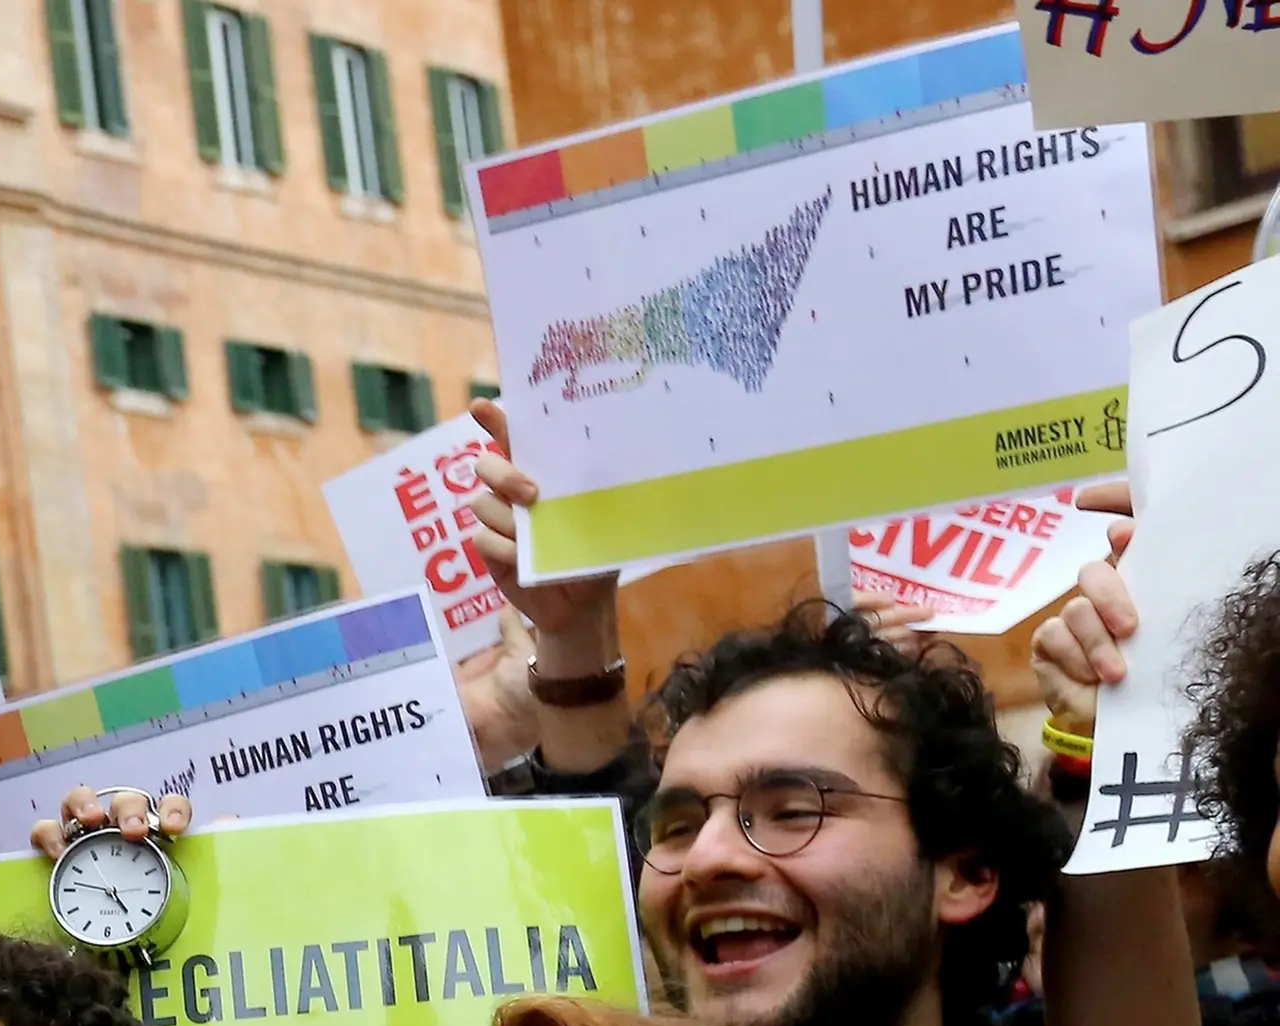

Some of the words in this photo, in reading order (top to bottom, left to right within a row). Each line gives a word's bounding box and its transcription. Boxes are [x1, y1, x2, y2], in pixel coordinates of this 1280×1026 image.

[850, 156, 963, 212] HUMAN
[976, 126, 1101, 182] RIGHTS
[947, 206, 1009, 250] ARE
[904, 279, 949, 319] MY
[962, 254, 1065, 306] PRIDE
[995, 416, 1087, 453] AMNESTY
[996, 441, 1089, 470] INTERNATIONAL
[411, 518, 449, 552] DI
[210, 731, 313, 785] HUMAN
[318, 700, 426, 754] RIGHTS
[304, 775, 361, 812] ARE
[110, 845, 122, 857] 12
[104, 926, 111, 938] 6
